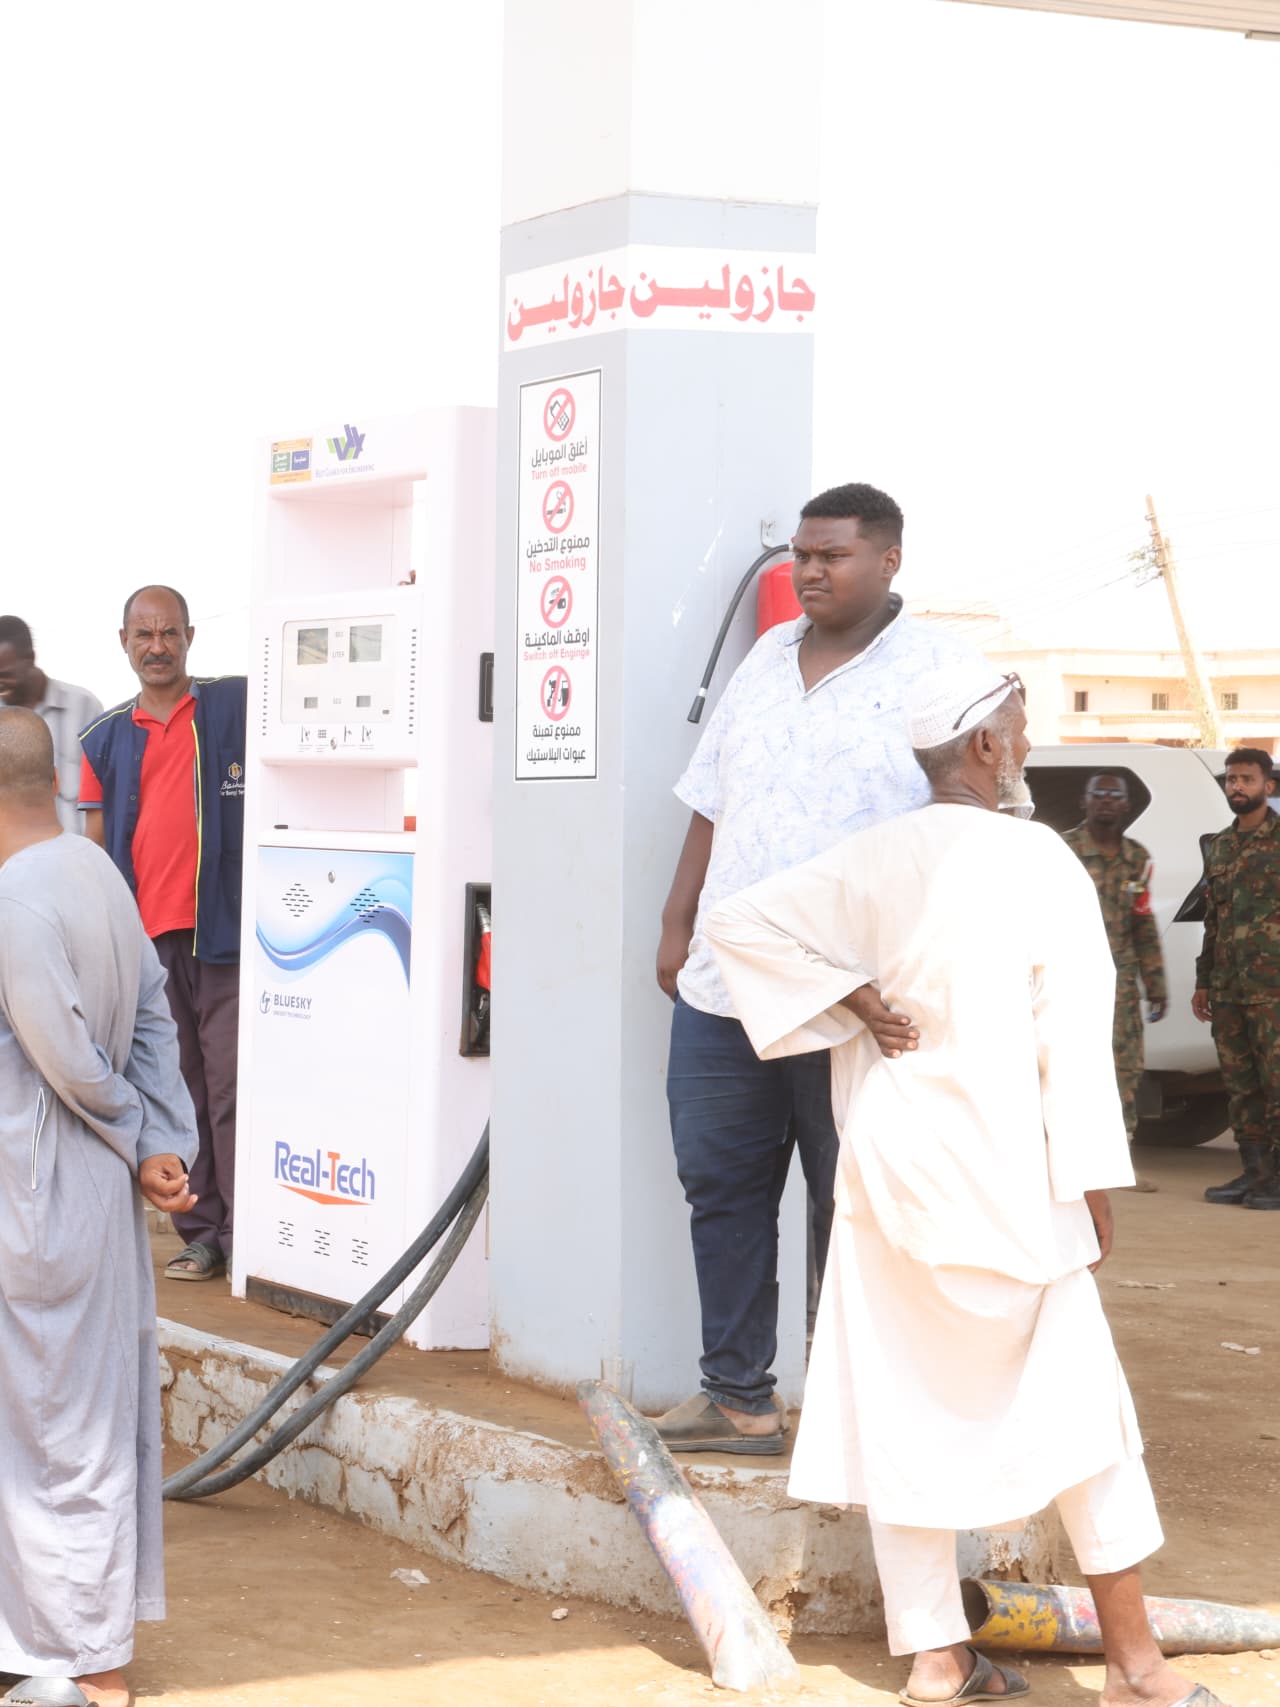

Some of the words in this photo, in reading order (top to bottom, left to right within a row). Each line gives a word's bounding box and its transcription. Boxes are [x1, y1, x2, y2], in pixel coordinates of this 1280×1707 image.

[507, 263, 626, 342] جازولين
[630, 263, 816, 323] جازولين
[531, 443, 567, 469] الموبايل
[531, 469, 549, 481] Turn
[549, 466, 559, 478] off
[561, 462, 588, 476] mobile
[526, 536, 559, 559] التدخين
[560, 535, 590, 555] ممنوع
[529, 560, 542, 574] No
[544, 556, 586, 572] Smoking
[555, 723, 581, 741] ممنوع
[563, 746, 587, 763] عبوات
[273, 993, 312, 1010] BLUESKY
[273, 1140, 376, 1200] Real-Tech
